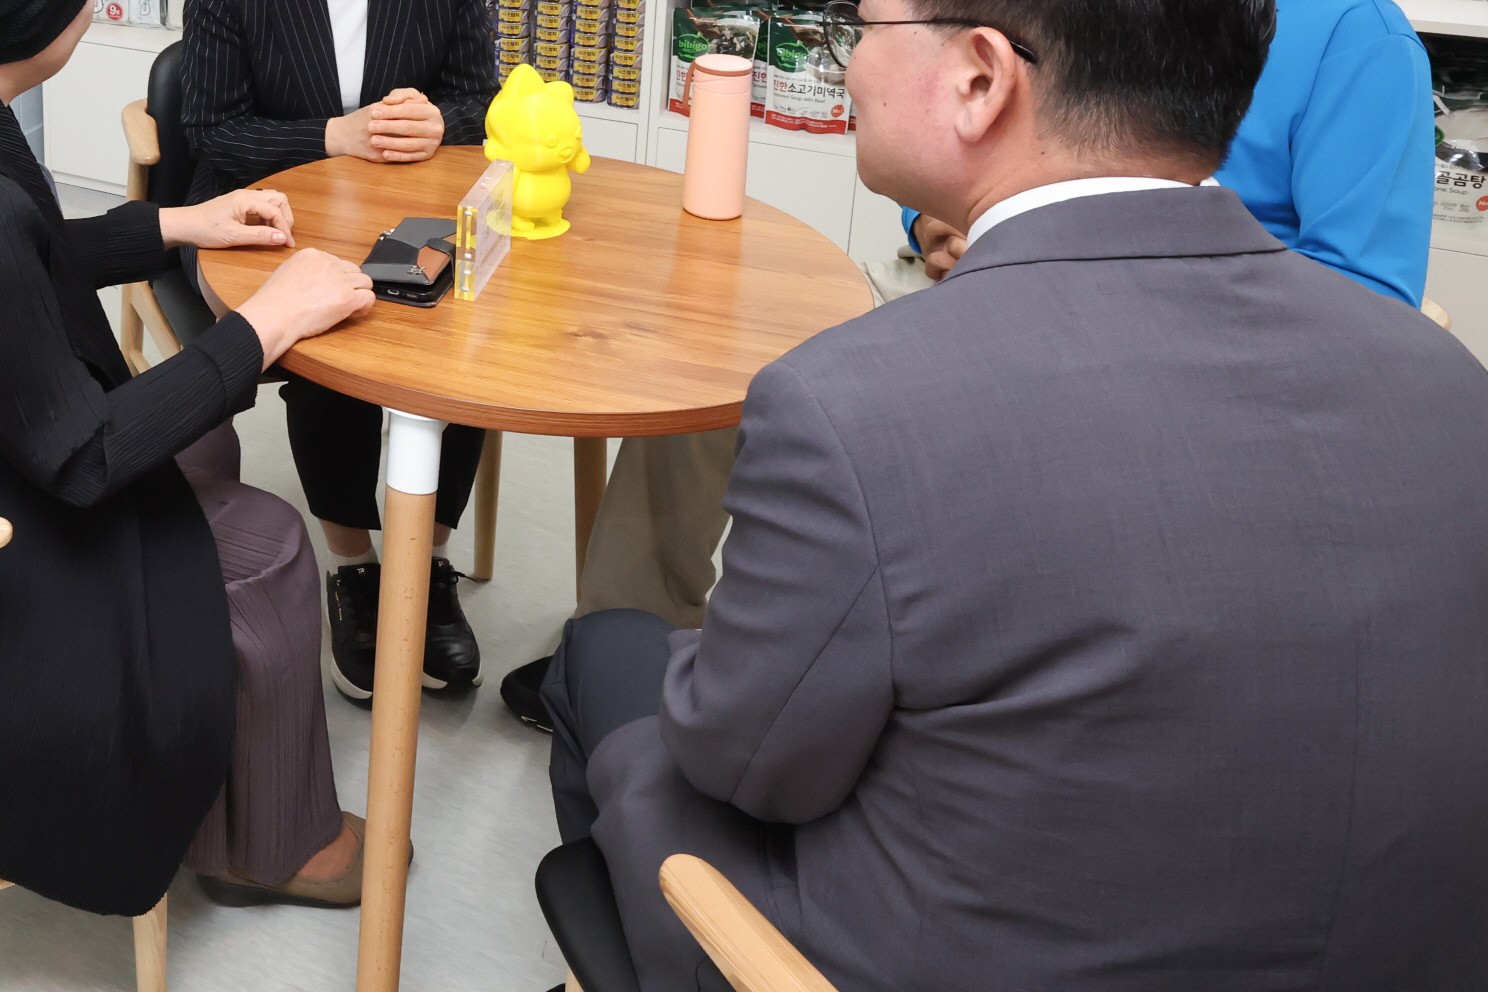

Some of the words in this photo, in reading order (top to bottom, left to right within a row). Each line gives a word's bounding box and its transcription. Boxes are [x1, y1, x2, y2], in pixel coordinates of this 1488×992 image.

[678, 39, 708, 52] bibigo
[773, 79, 845, 100] 진한소고기미역국
[1437, 170, 1487, 190] 골곰탕
[1449, 188, 1469, 196] Soup
